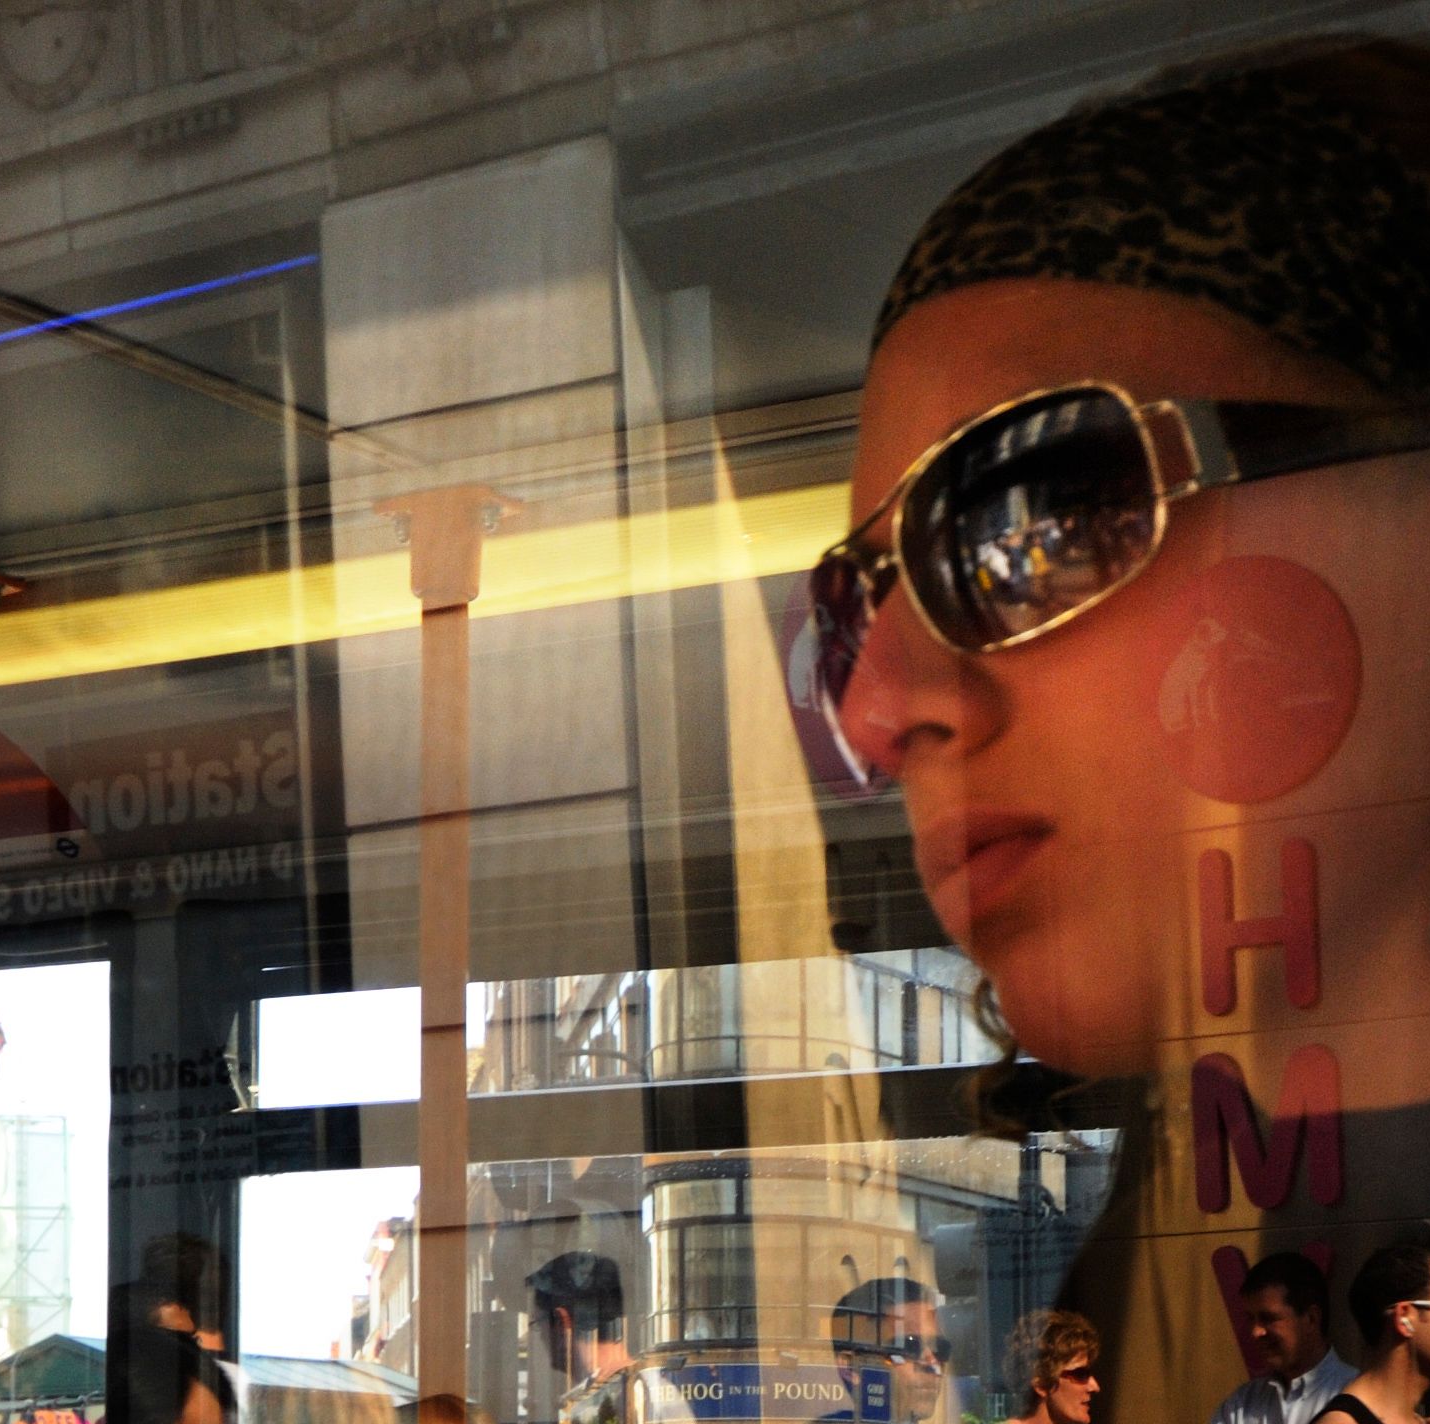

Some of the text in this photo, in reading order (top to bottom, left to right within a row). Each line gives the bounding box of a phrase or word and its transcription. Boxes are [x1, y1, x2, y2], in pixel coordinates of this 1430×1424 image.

[680, 1382, 723, 1401] HOG
[729, 1385, 742, 1396] IN
[746, 1385, 766, 1397] THE
[773, 1382, 845, 1402] POUND
